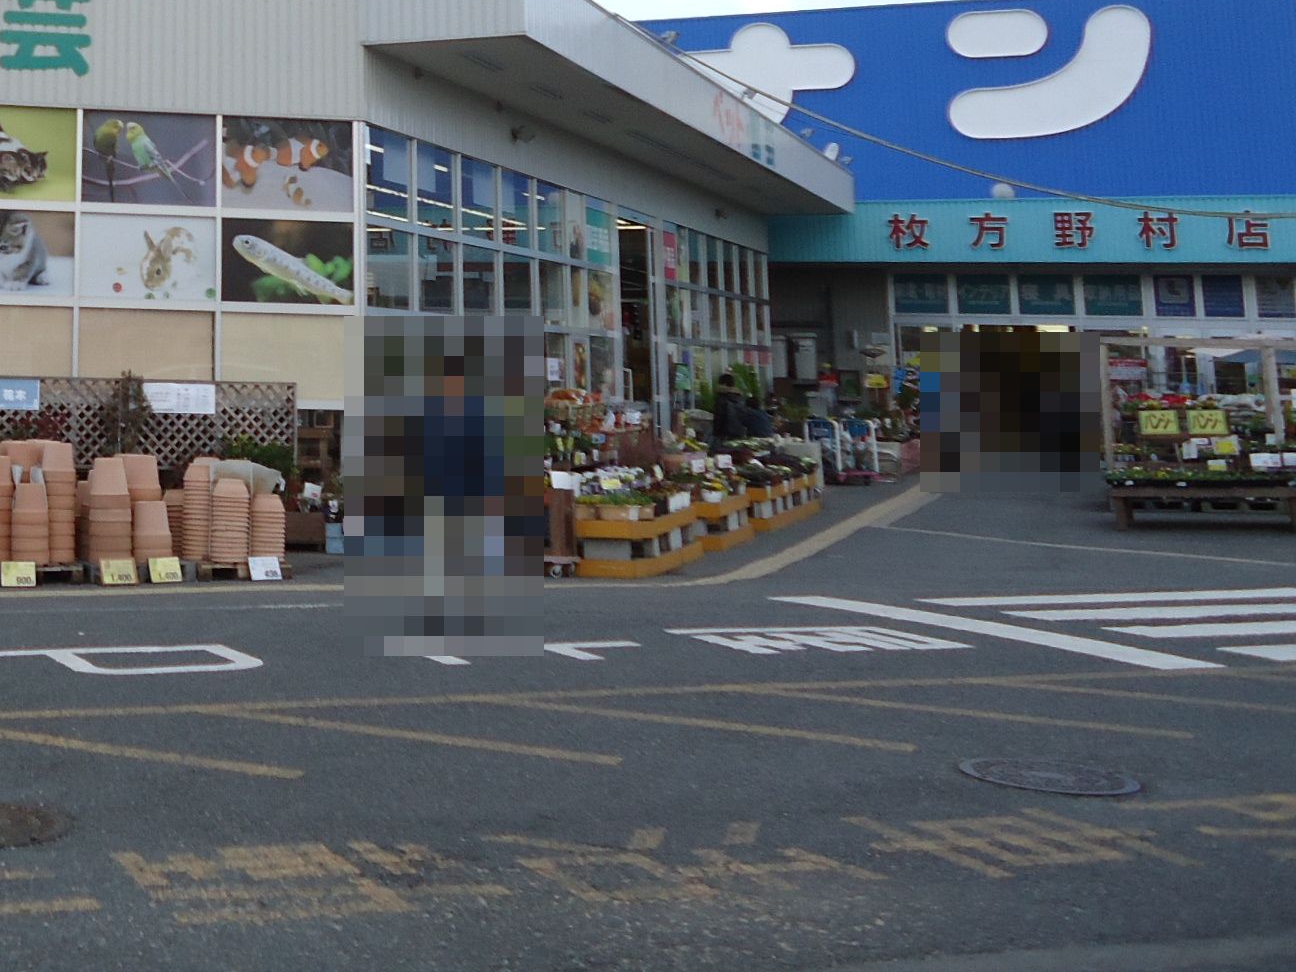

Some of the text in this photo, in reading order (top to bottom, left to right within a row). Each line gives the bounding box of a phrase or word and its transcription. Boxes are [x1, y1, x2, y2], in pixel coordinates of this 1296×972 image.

[887, 209, 1272, 251] 枚方野村店
